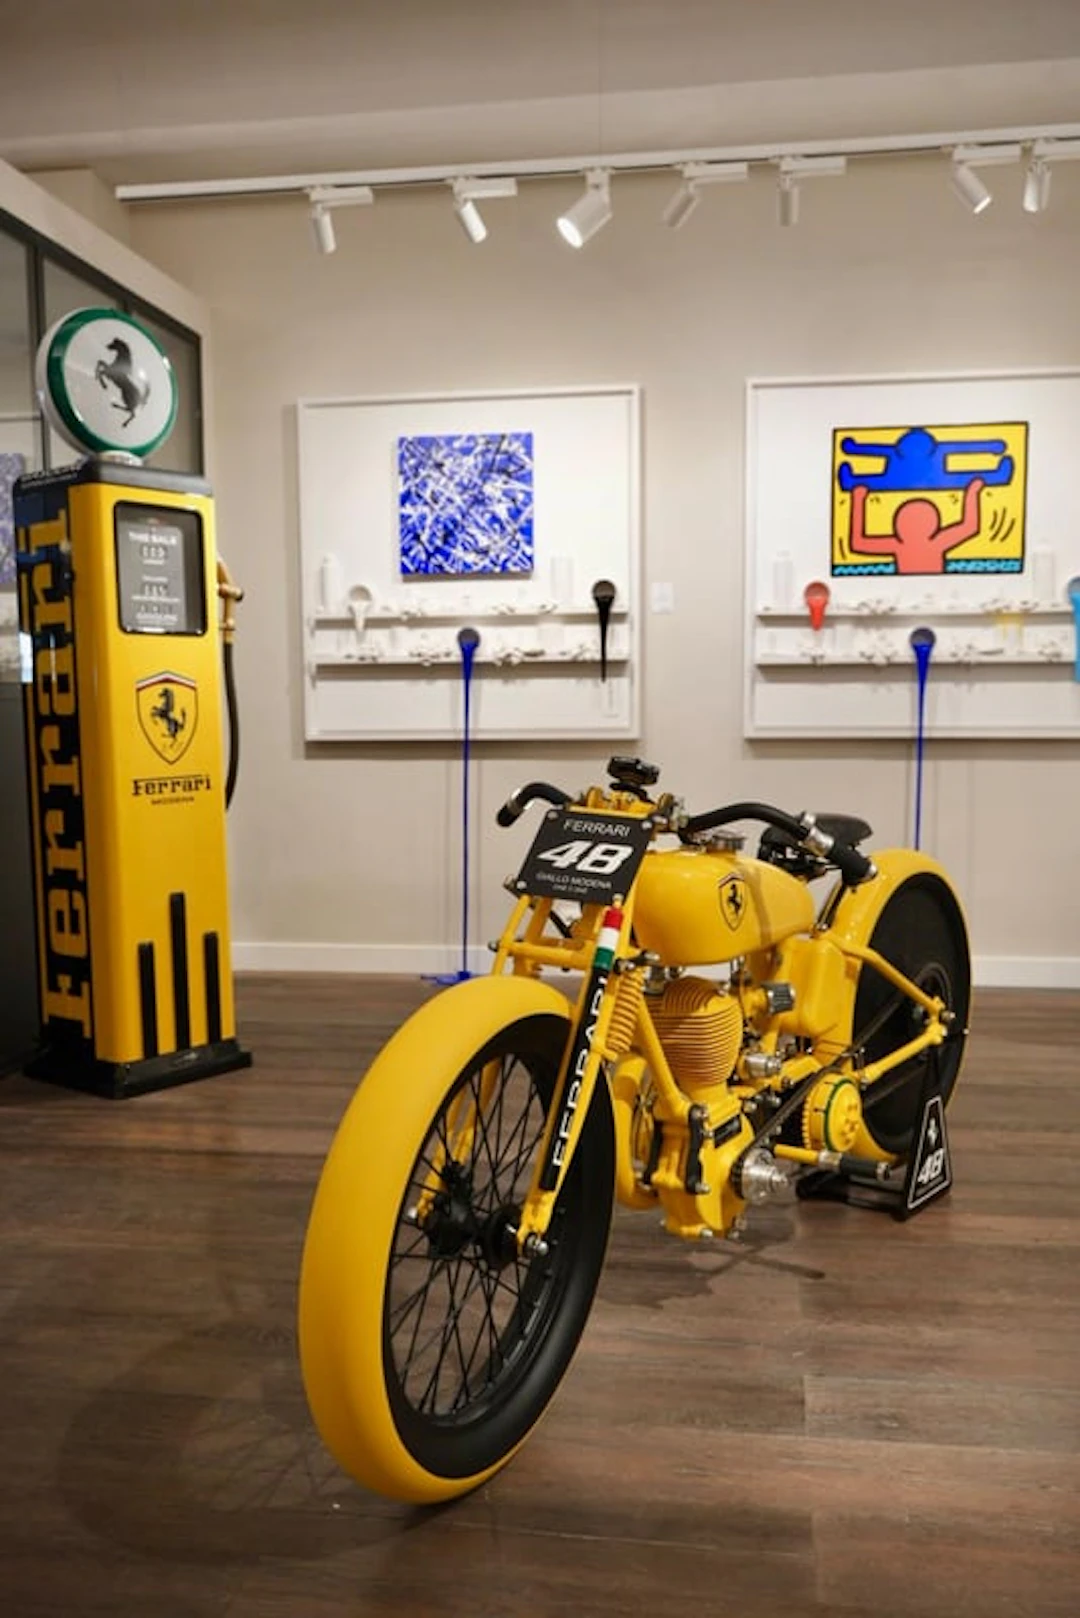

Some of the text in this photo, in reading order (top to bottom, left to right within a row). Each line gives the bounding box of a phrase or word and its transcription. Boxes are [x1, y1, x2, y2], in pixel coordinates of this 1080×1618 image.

[18, 508, 92, 1039] Ferrari
[132, 774, 211, 796] Ferrari
[563, 819, 631, 837] FERRARI
[537, 840, 634, 875] 48
[917, 1147, 945, 1184] 48
